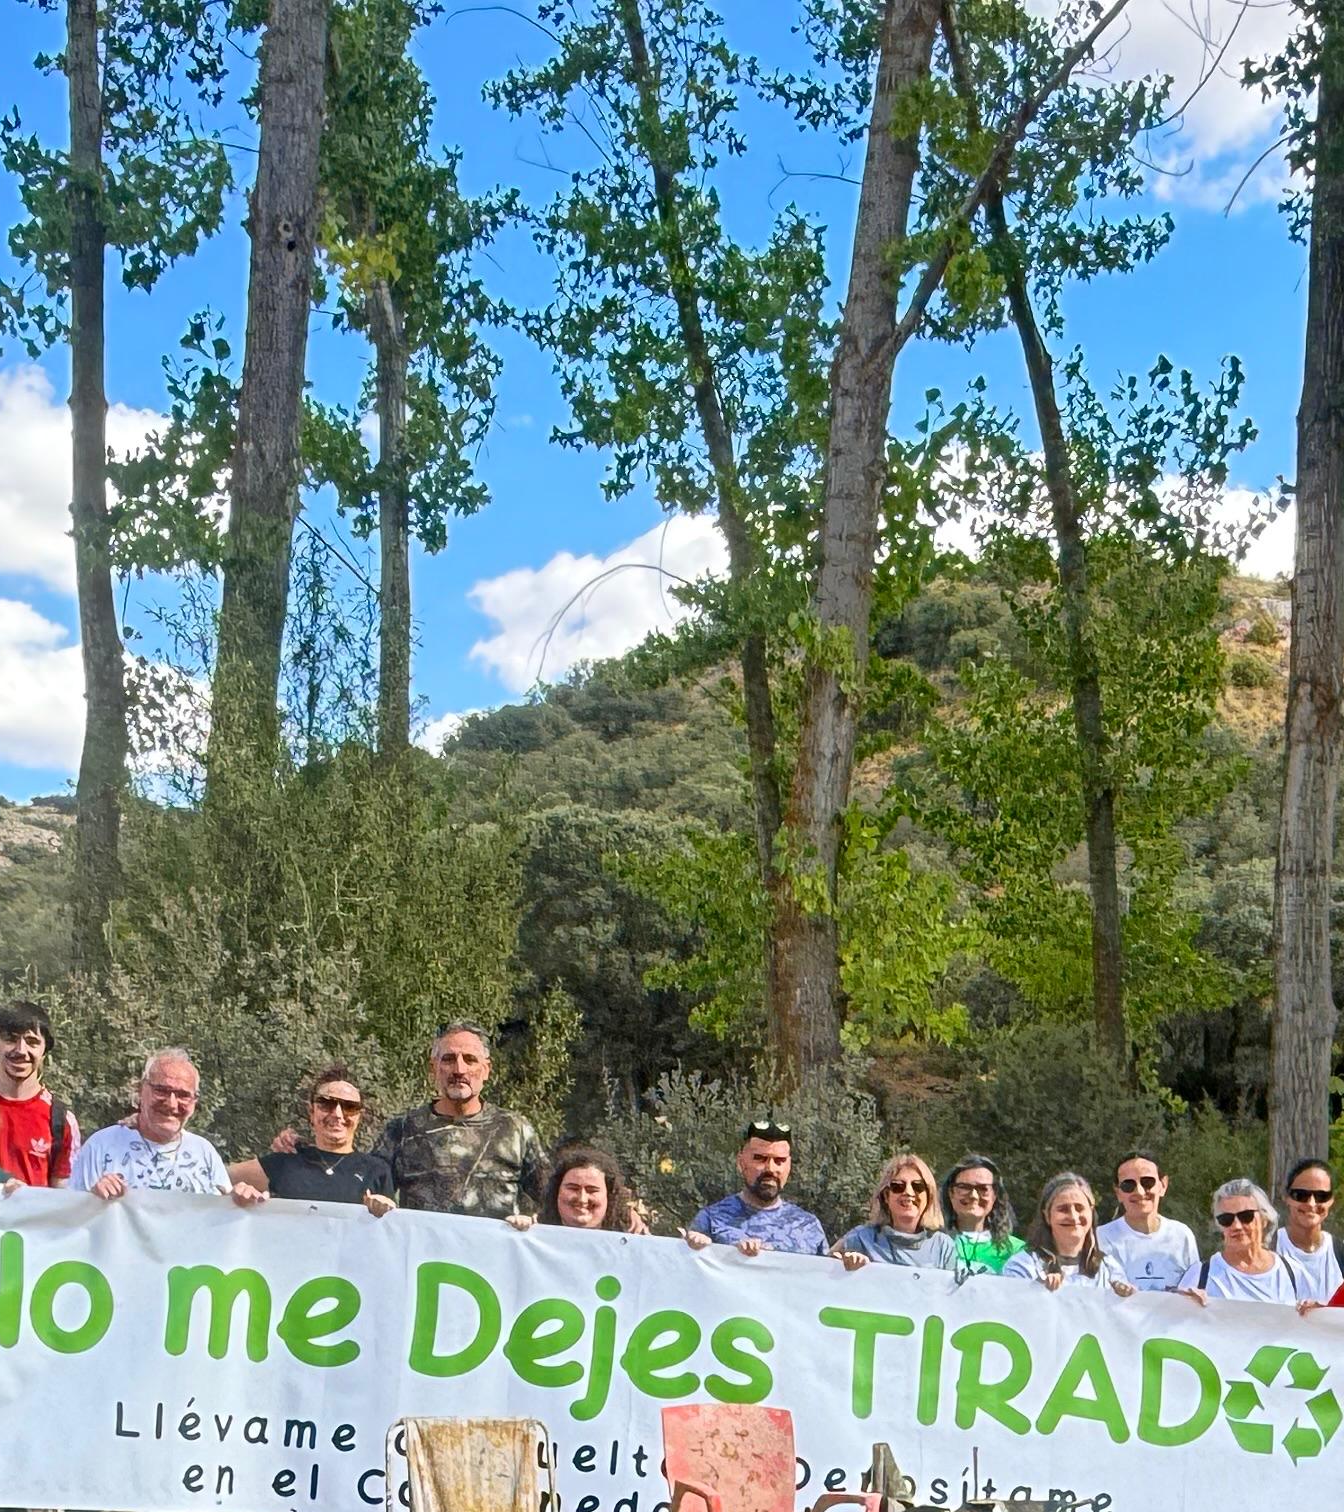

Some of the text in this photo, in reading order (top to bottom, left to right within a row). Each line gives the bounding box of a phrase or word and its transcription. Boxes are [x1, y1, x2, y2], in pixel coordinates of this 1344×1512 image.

[164, 1265, 362, 1368] me
[409, 1261, 774, 1421] Dejes
[115, 1397, 356, 1452] Llévame
[182, 1464, 234, 1495] en
[271, 1462, 319, 1500] el
